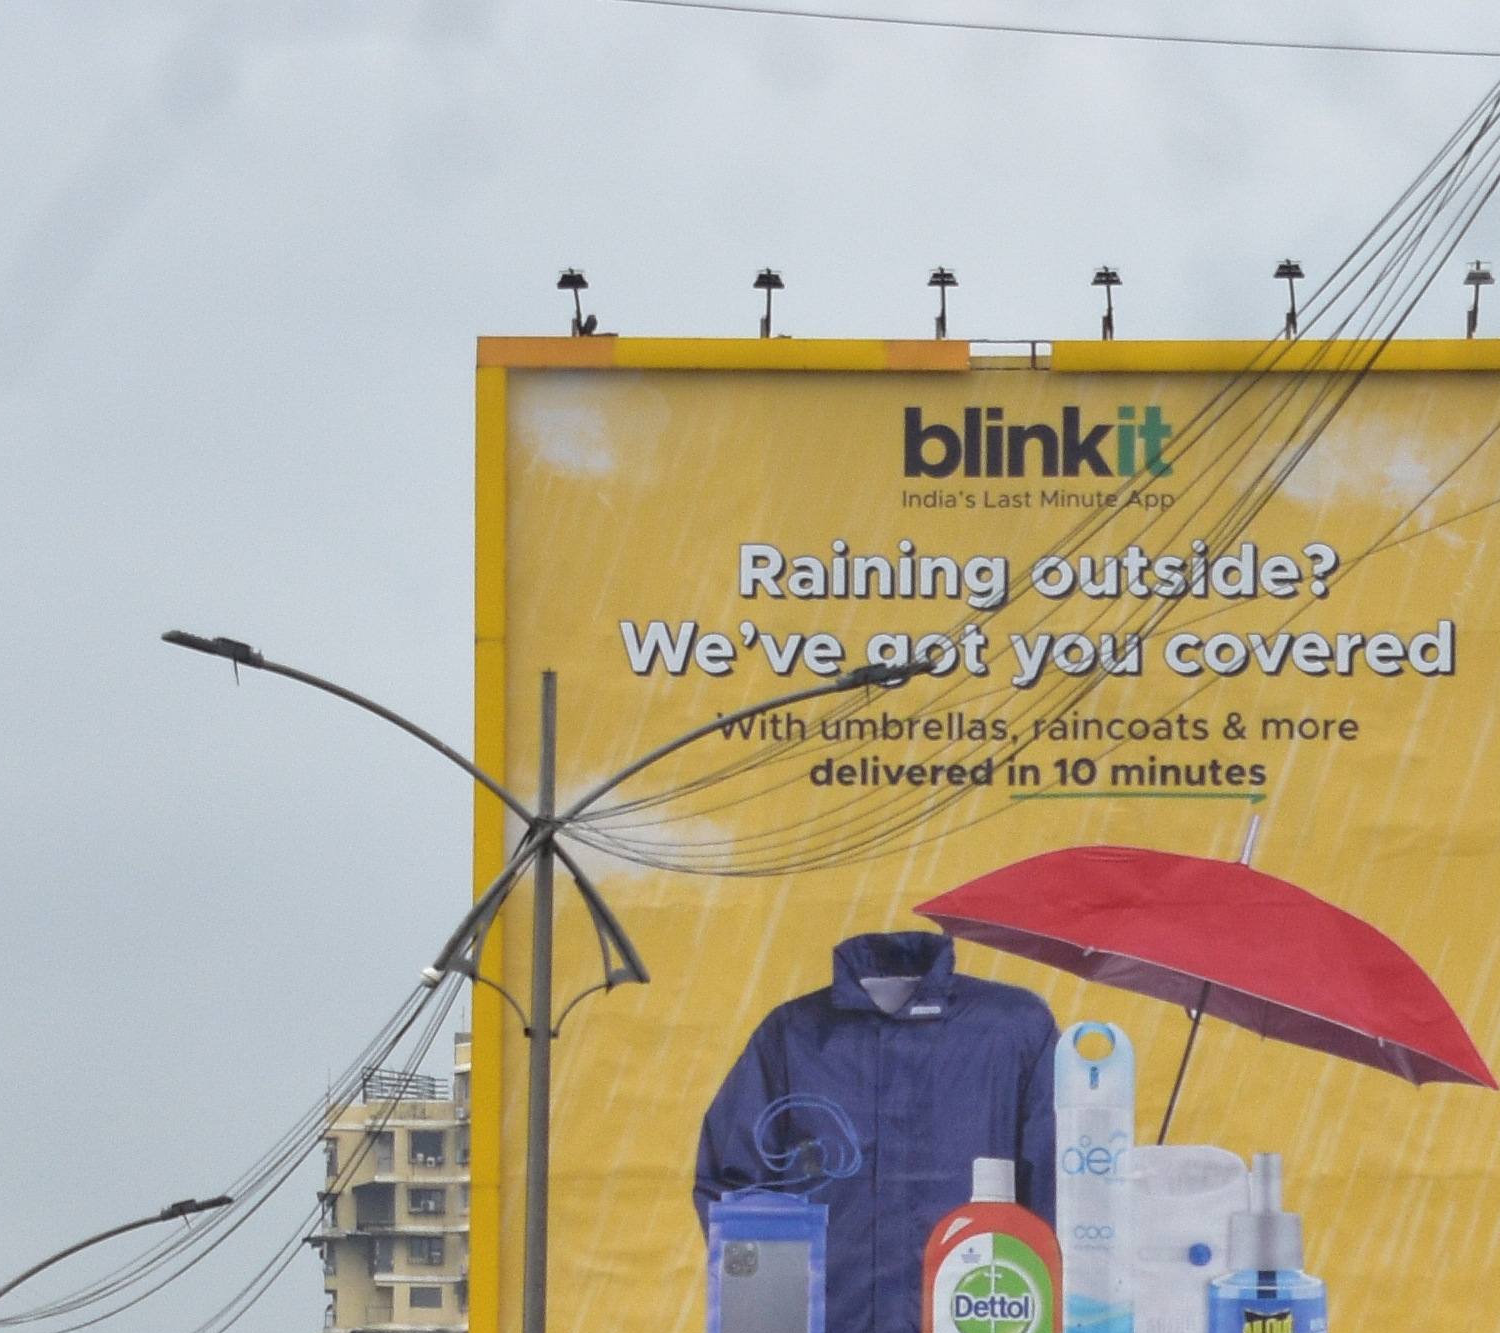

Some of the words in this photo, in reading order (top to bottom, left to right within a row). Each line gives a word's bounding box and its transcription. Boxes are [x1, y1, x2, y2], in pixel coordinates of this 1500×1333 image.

[904, 406, 1174, 478] blinkit
[902, 489, 976, 510] India's
[982, 489, 1023, 510] Last
[1029, 489, 1117, 510] Minute
[1124, 489, 1175, 515] App
[739, 541, 1009, 607] Raining
[1033, 541, 1339, 600] outside?
[621, 619, 840, 677] We've
[870, 626, 987, 688] got
[1012, 635, 1142, 688] you
[1164, 619, 1457, 678] covered
[719, 711, 807, 742] With
[821, 711, 1018, 745] umbrellas,
[1033, 712, 1208, 742] raincoats
[1223, 714, 1247, 742] &
[1262, 718, 1359, 742] more
[810, 757, 995, 787] delivered
[1008, 757, 1041, 787] in
[1053, 759, 1097, 787] 10
[1111, 757, 1267, 787] minutes
[954, 1294, 1030, 1319] Dettol
